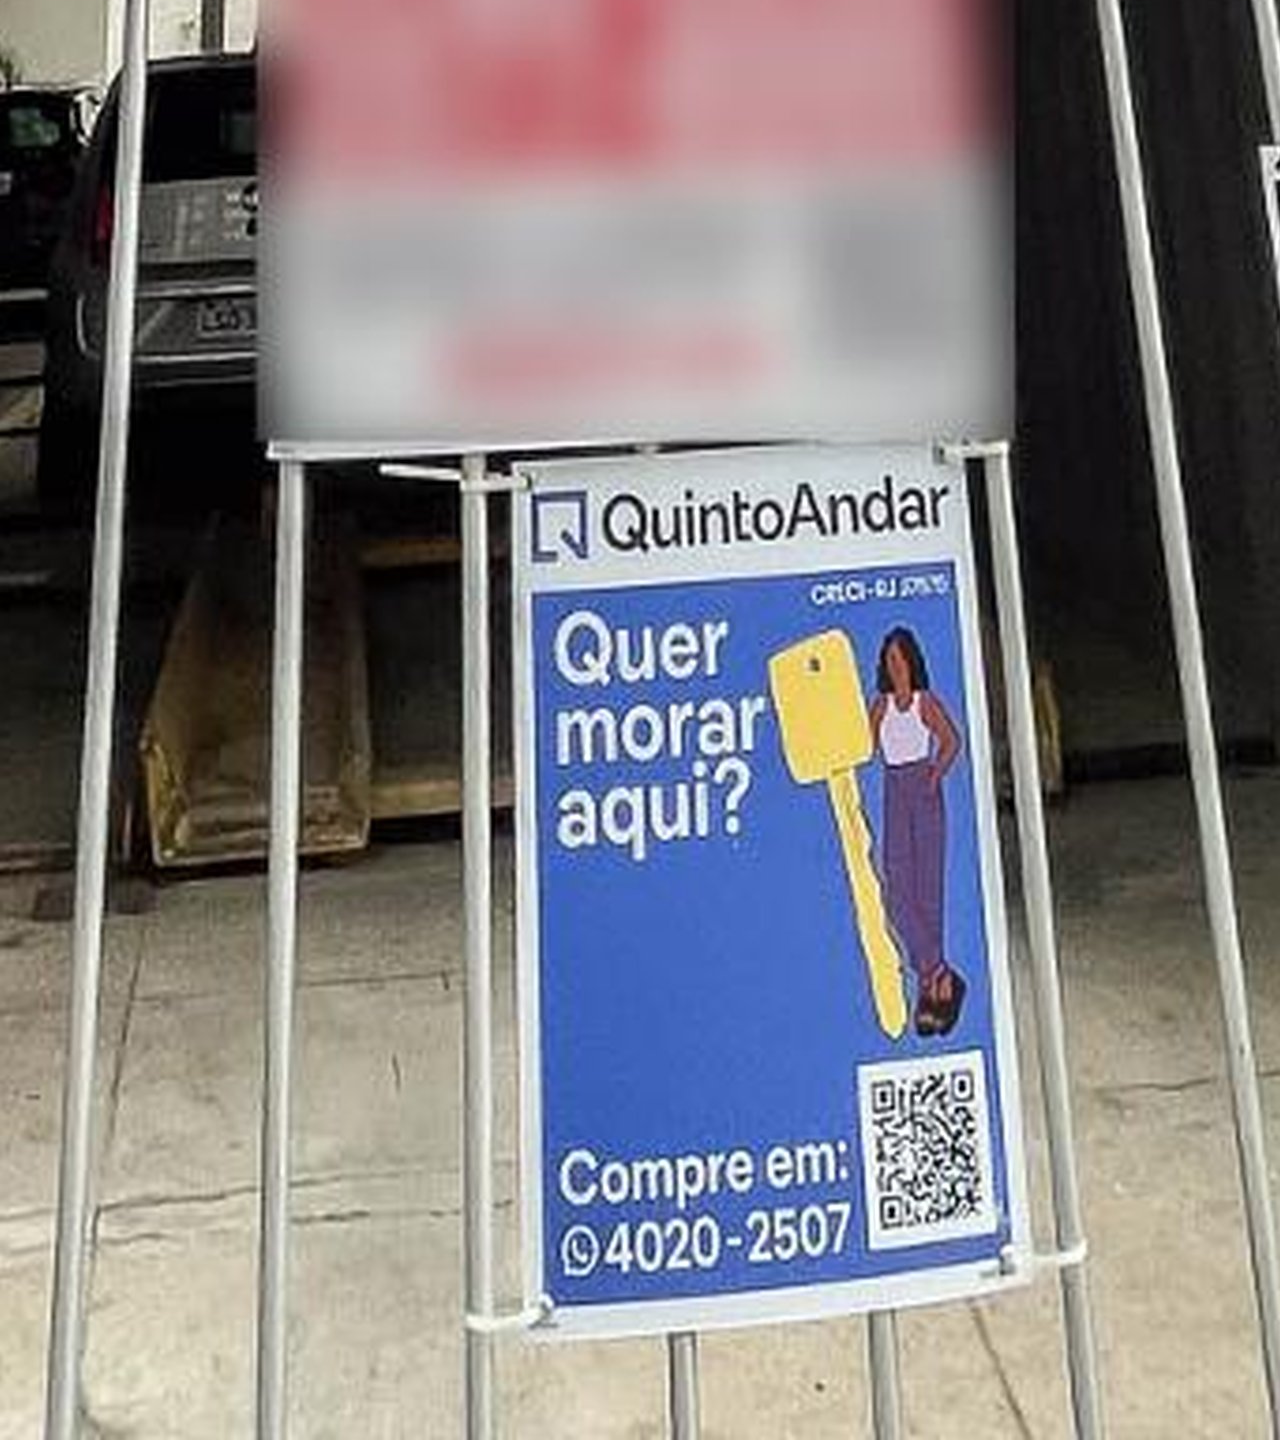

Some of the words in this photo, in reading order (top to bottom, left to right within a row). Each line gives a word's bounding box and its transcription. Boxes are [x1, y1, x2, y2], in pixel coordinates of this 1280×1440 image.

[602, 476, 950, 552] QuintoAndar
[553, 610, 727, 685] Quer
[556, 690, 766, 765] morar
[555, 760, 750, 861] aqui?
[559, 1148, 756, 1208] Compre
[765, 1140, 849, 1188] em:
[605, 1203, 851, 1270] 4020-2507
